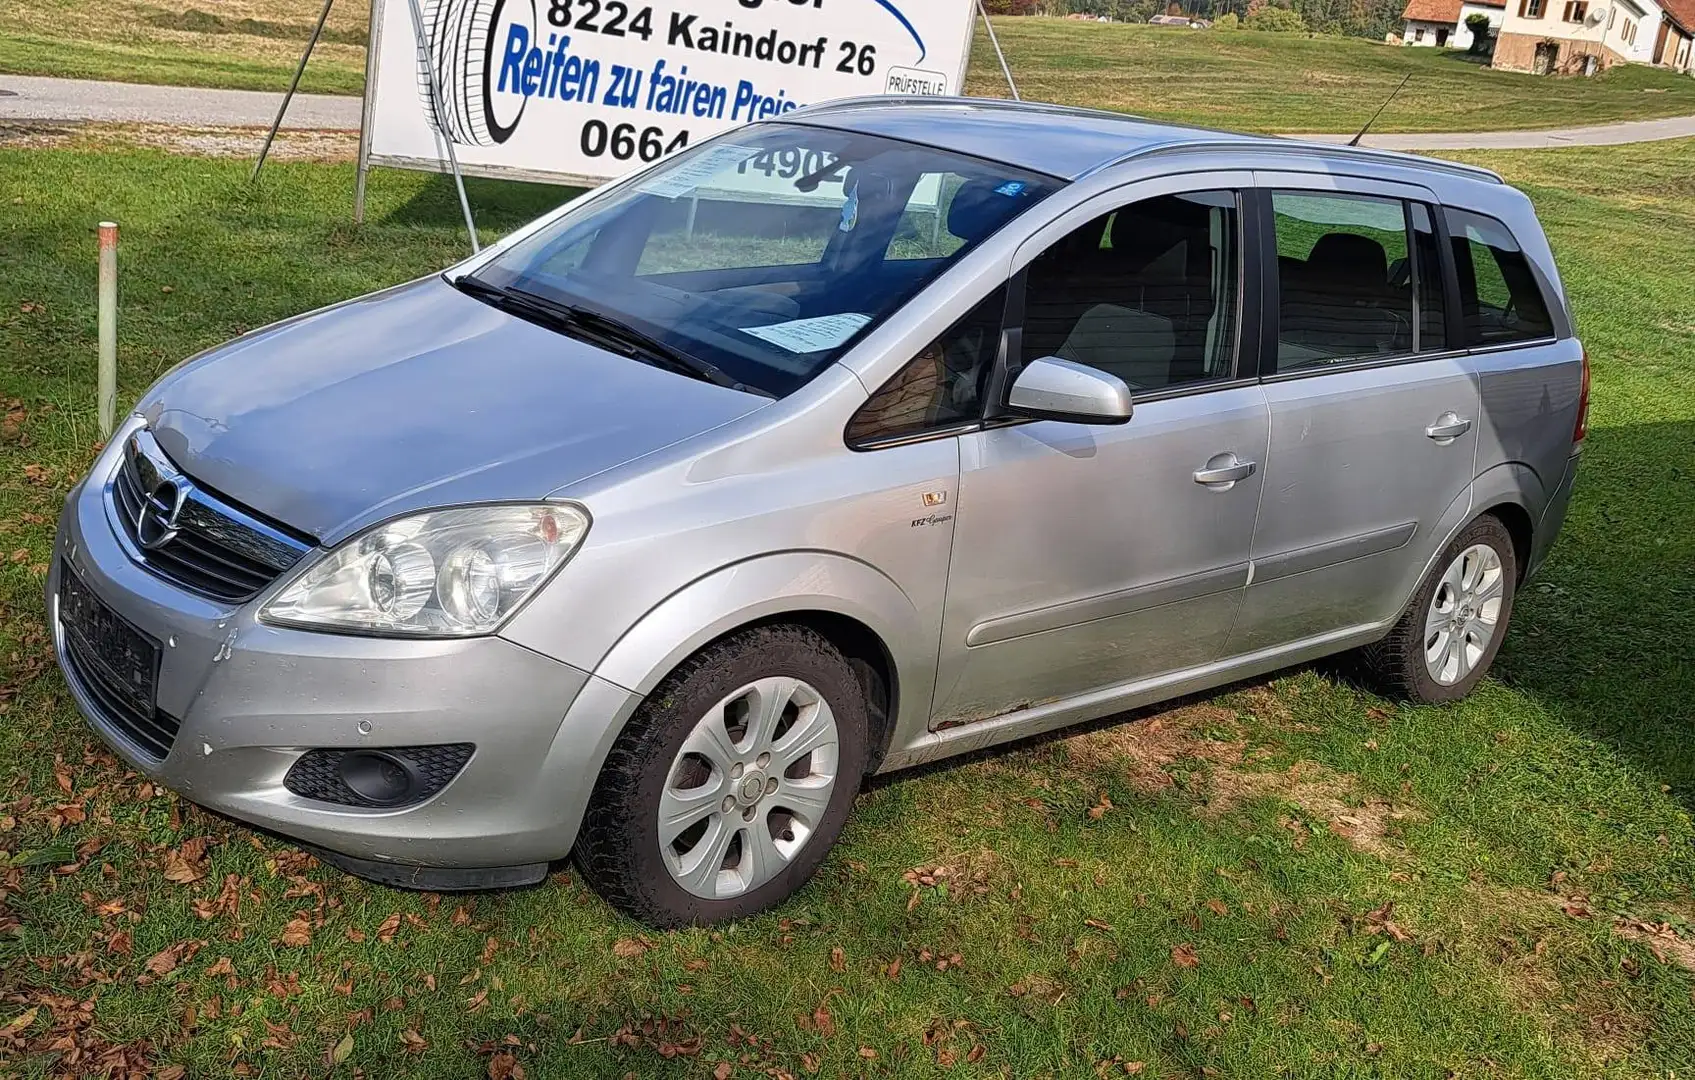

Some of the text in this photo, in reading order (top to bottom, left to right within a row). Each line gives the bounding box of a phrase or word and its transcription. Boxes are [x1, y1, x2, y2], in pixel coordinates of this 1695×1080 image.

[497, 23, 807, 122] Reifen zu fairen Preis
[547, 0, 877, 76] 8224 Kaindorf 26
[888, 74, 945, 95] PRÜFSTELLE
